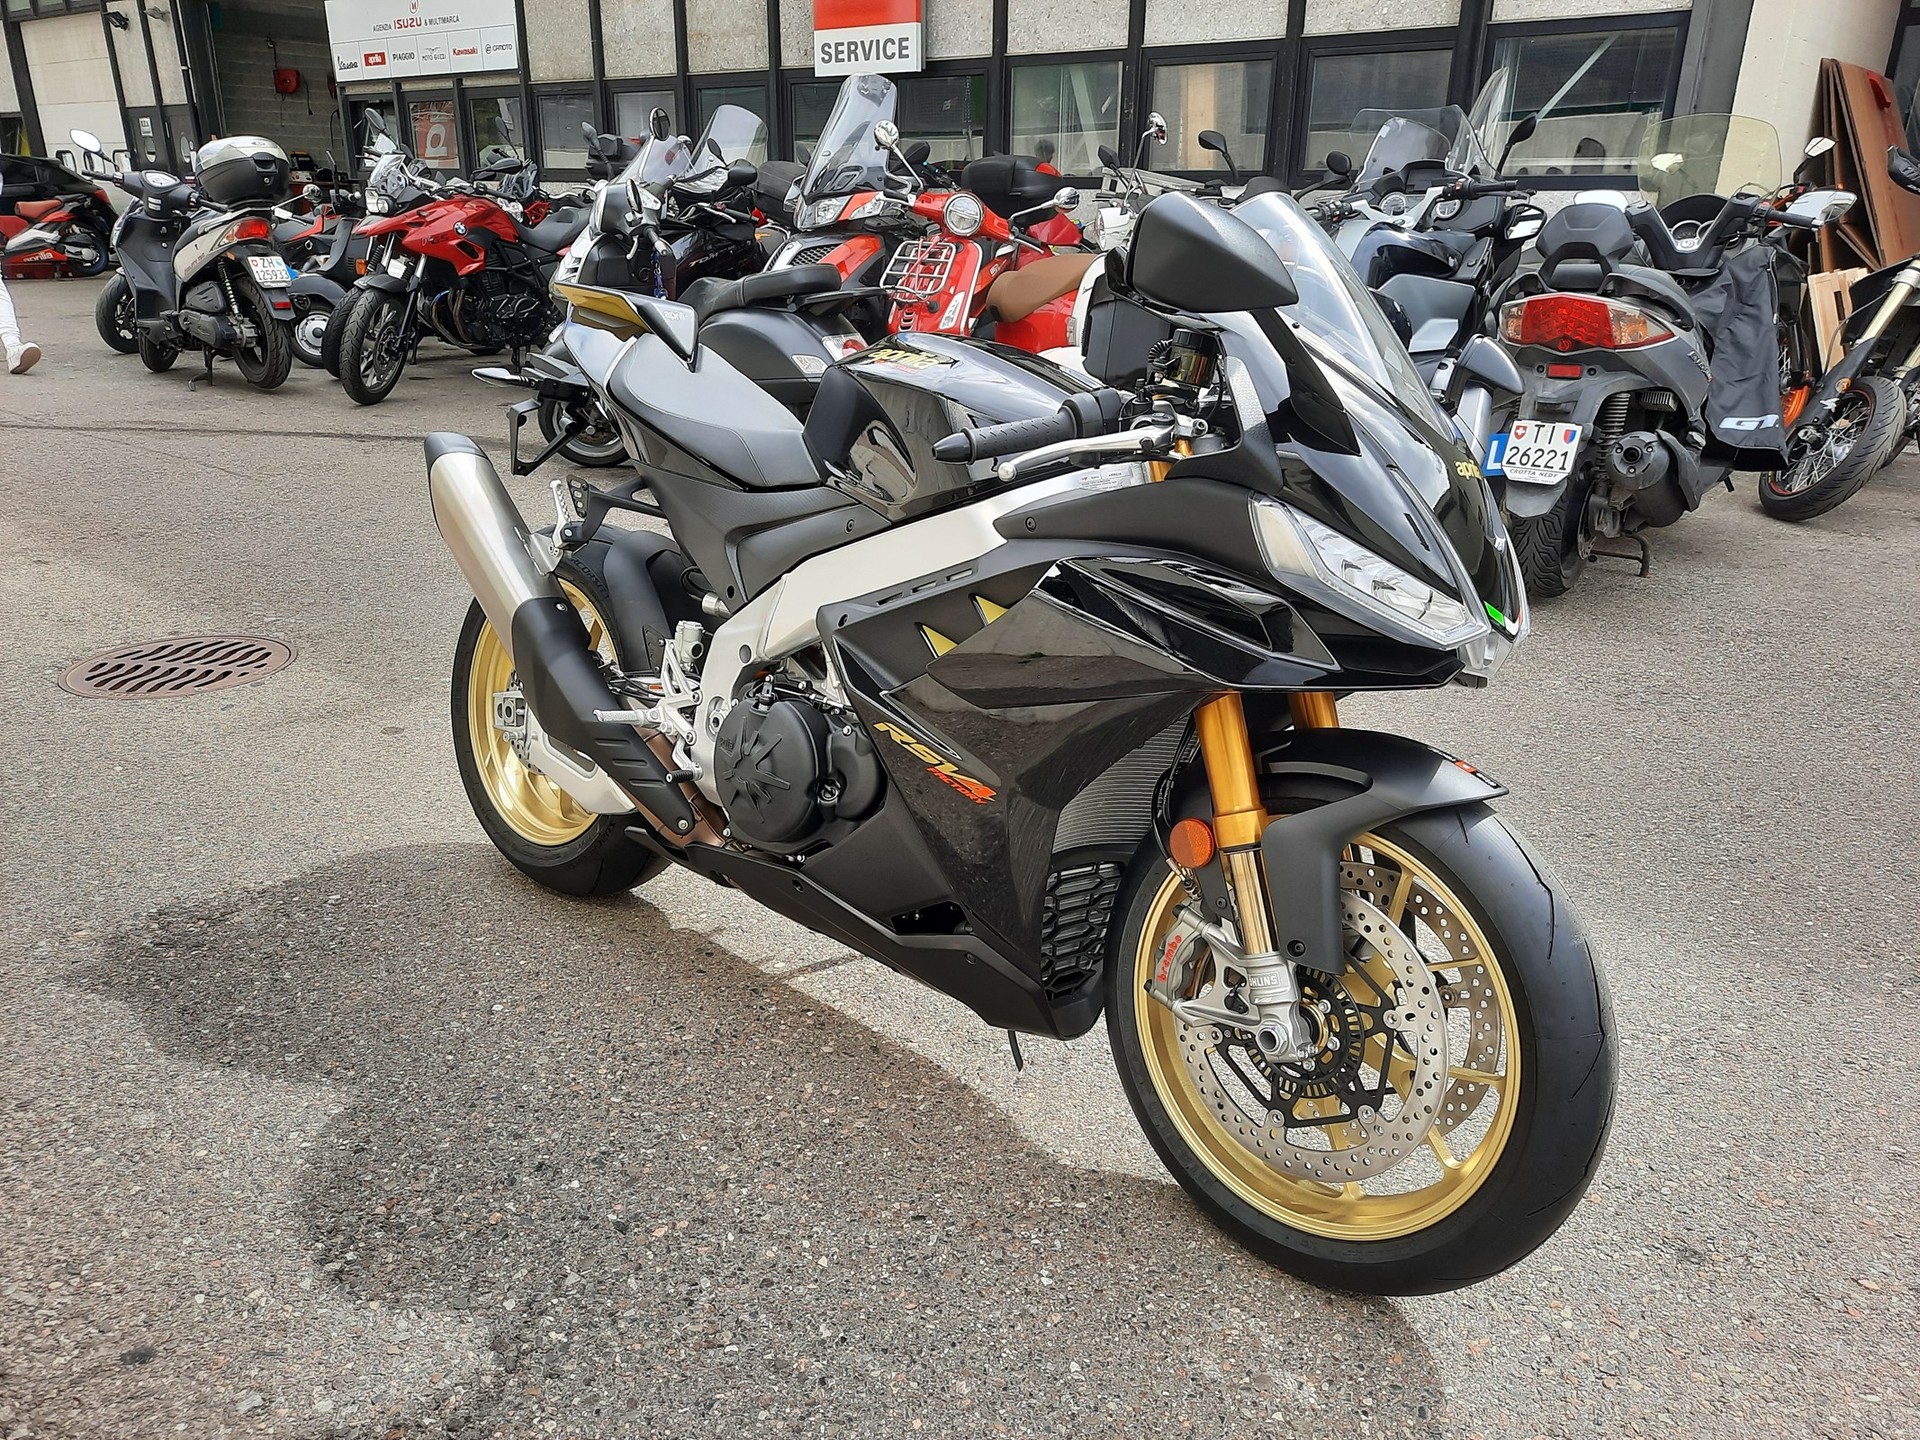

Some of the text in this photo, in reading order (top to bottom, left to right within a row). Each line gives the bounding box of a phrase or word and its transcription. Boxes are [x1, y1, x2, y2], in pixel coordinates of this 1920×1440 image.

[373, 24, 392, 32] AGENZIA
[393, 17, 423, 30] ISUZU
[429, 15, 460, 25] MULTIMARCA
[392, 52, 415, 61] PIAGGIO
[452, 46, 479, 56] Kawasaki
[821, 37, 910, 64] SERVICE
[259, 258, 275, 268] ZH
[256, 269, 290, 280] 125933
[1533, 424, 1556, 445] TI
[1486, 440, 1502, 470] L
[1506, 446, 1569, 471] 26221
[1509, 468, 1536, 476] CROTTA
[1156, 935, 1183, 983] brembo
